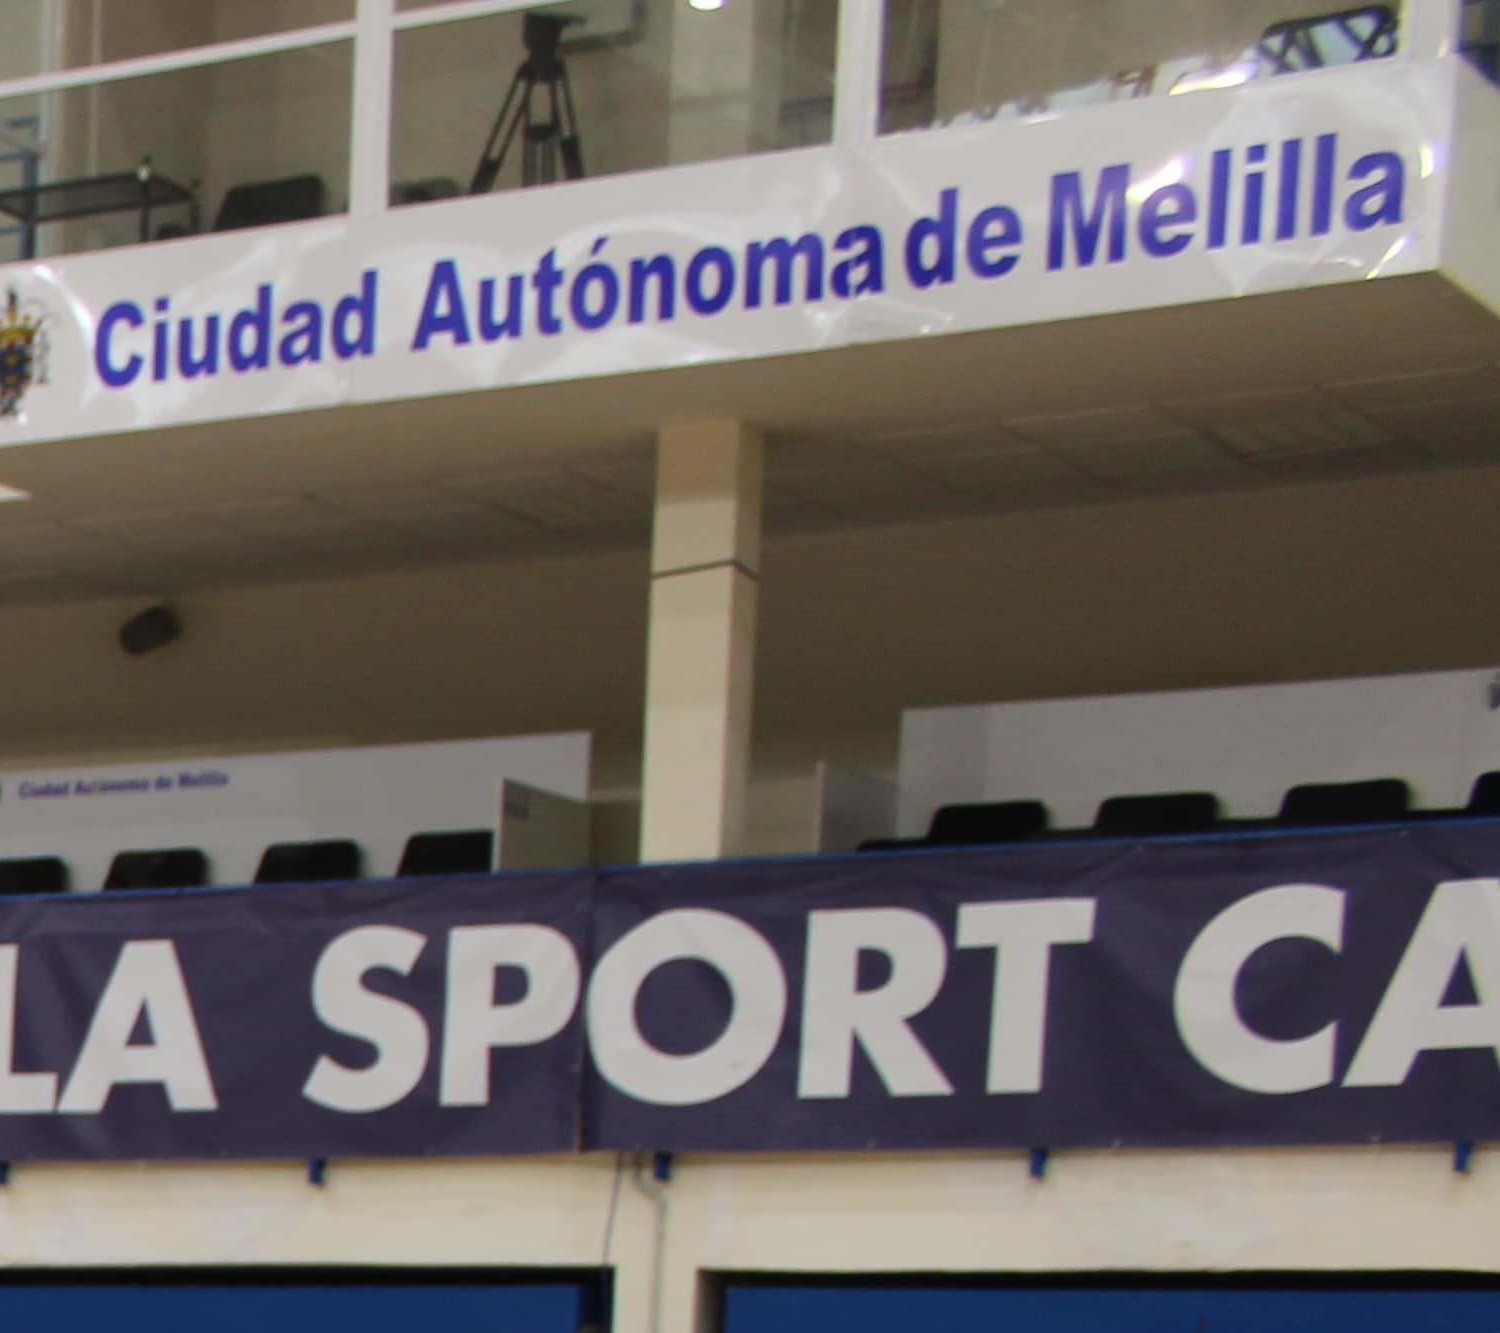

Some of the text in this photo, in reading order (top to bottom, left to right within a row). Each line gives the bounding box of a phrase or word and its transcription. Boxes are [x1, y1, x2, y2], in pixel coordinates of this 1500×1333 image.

[94, 133, 1404, 389] Ciudad Autónoma de Melilla
[302, 897, 1097, 1114] SPORT
